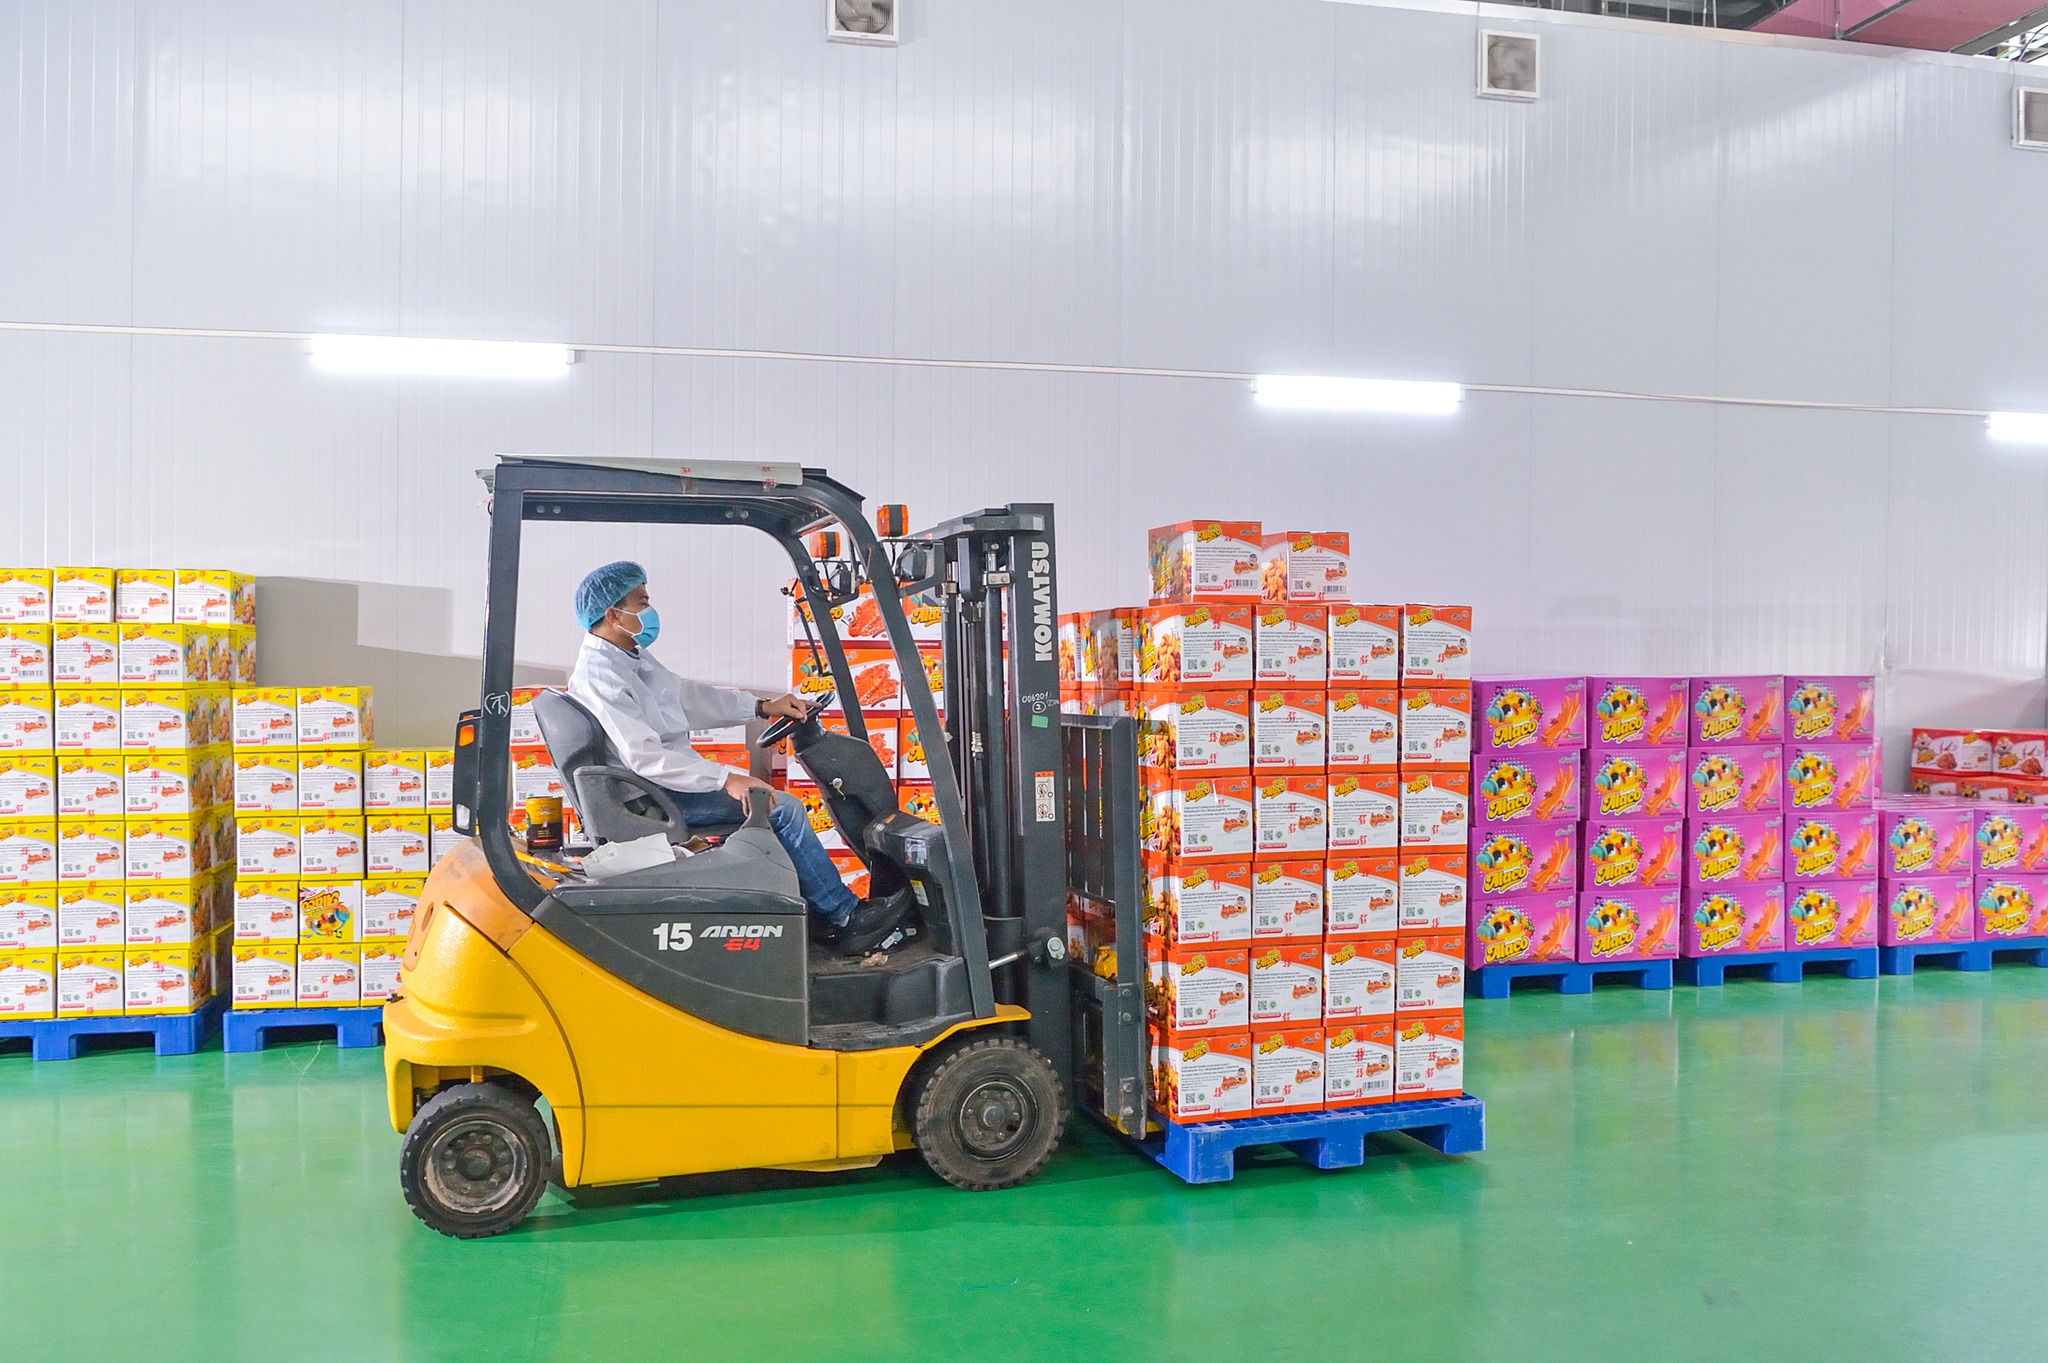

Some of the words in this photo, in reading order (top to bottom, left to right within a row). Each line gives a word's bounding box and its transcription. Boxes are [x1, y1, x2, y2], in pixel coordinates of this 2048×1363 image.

[1028, 541, 1052, 661] KOMATSU
[912, 608, 941, 627] Alac
[800, 678, 835, 694] Alac
[1494, 720, 1537, 746] Alaco
[1603, 717, 1643, 742] Alaco
[1702, 715, 1741, 740] Alaco
[1794, 714, 1834, 738] Alaco
[1488, 793, 1532, 819] Alaco
[1601, 789, 1642, 814] Alaco
[1700, 786, 1739, 809] Alaco
[1794, 783, 1834, 806] Alaco
[1700, 855, 1740, 880] Alaco
[1796, 851, 1836, 875] Alaco
[1895, 849, 1933, 871] Alaco
[1982, 846, 2018, 868] Alaco
[1484, 866, 1527, 891] Alaco
[1596, 860, 1638, 885] Alaco
[302, 891, 340, 911] Alaco
[1797, 920, 1835, 945] Alaco
[1897, 915, 1933, 939] Alaco
[1986, 912, 2029, 934] Alaco
[653, 923, 693, 951] 15
[700, 925, 783, 938] ARION
[723, 938, 760, 951] E4
[1485, 937, 1530, 962] Alaco
[1593, 931, 1635, 956] Alaco
[1700, 925, 1741, 950] Alaco
